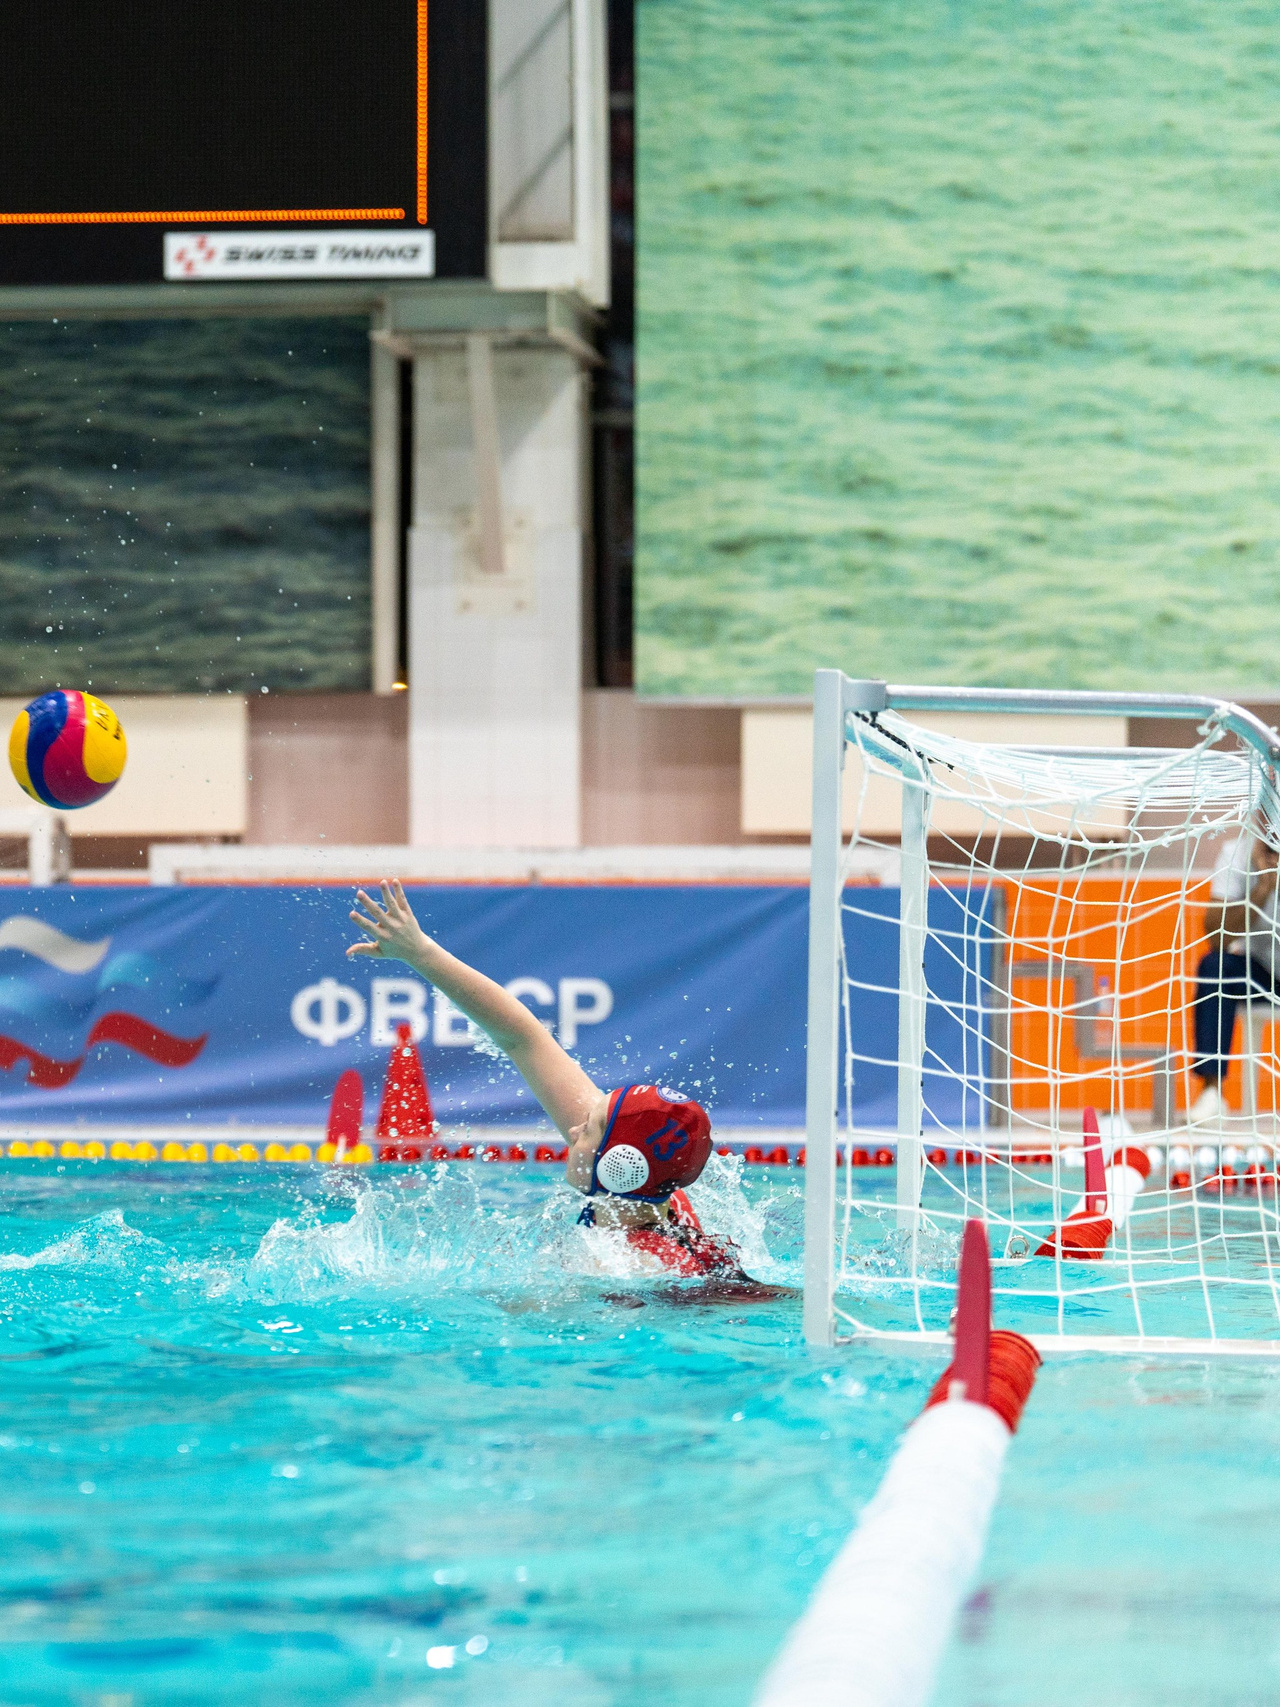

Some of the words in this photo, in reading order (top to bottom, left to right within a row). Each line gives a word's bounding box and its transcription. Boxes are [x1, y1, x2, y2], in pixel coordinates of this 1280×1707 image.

[225, 245, 318, 264] SWISS
[326, 244, 420, 263] TIMING
[645, 1117, 689, 1162] 13
